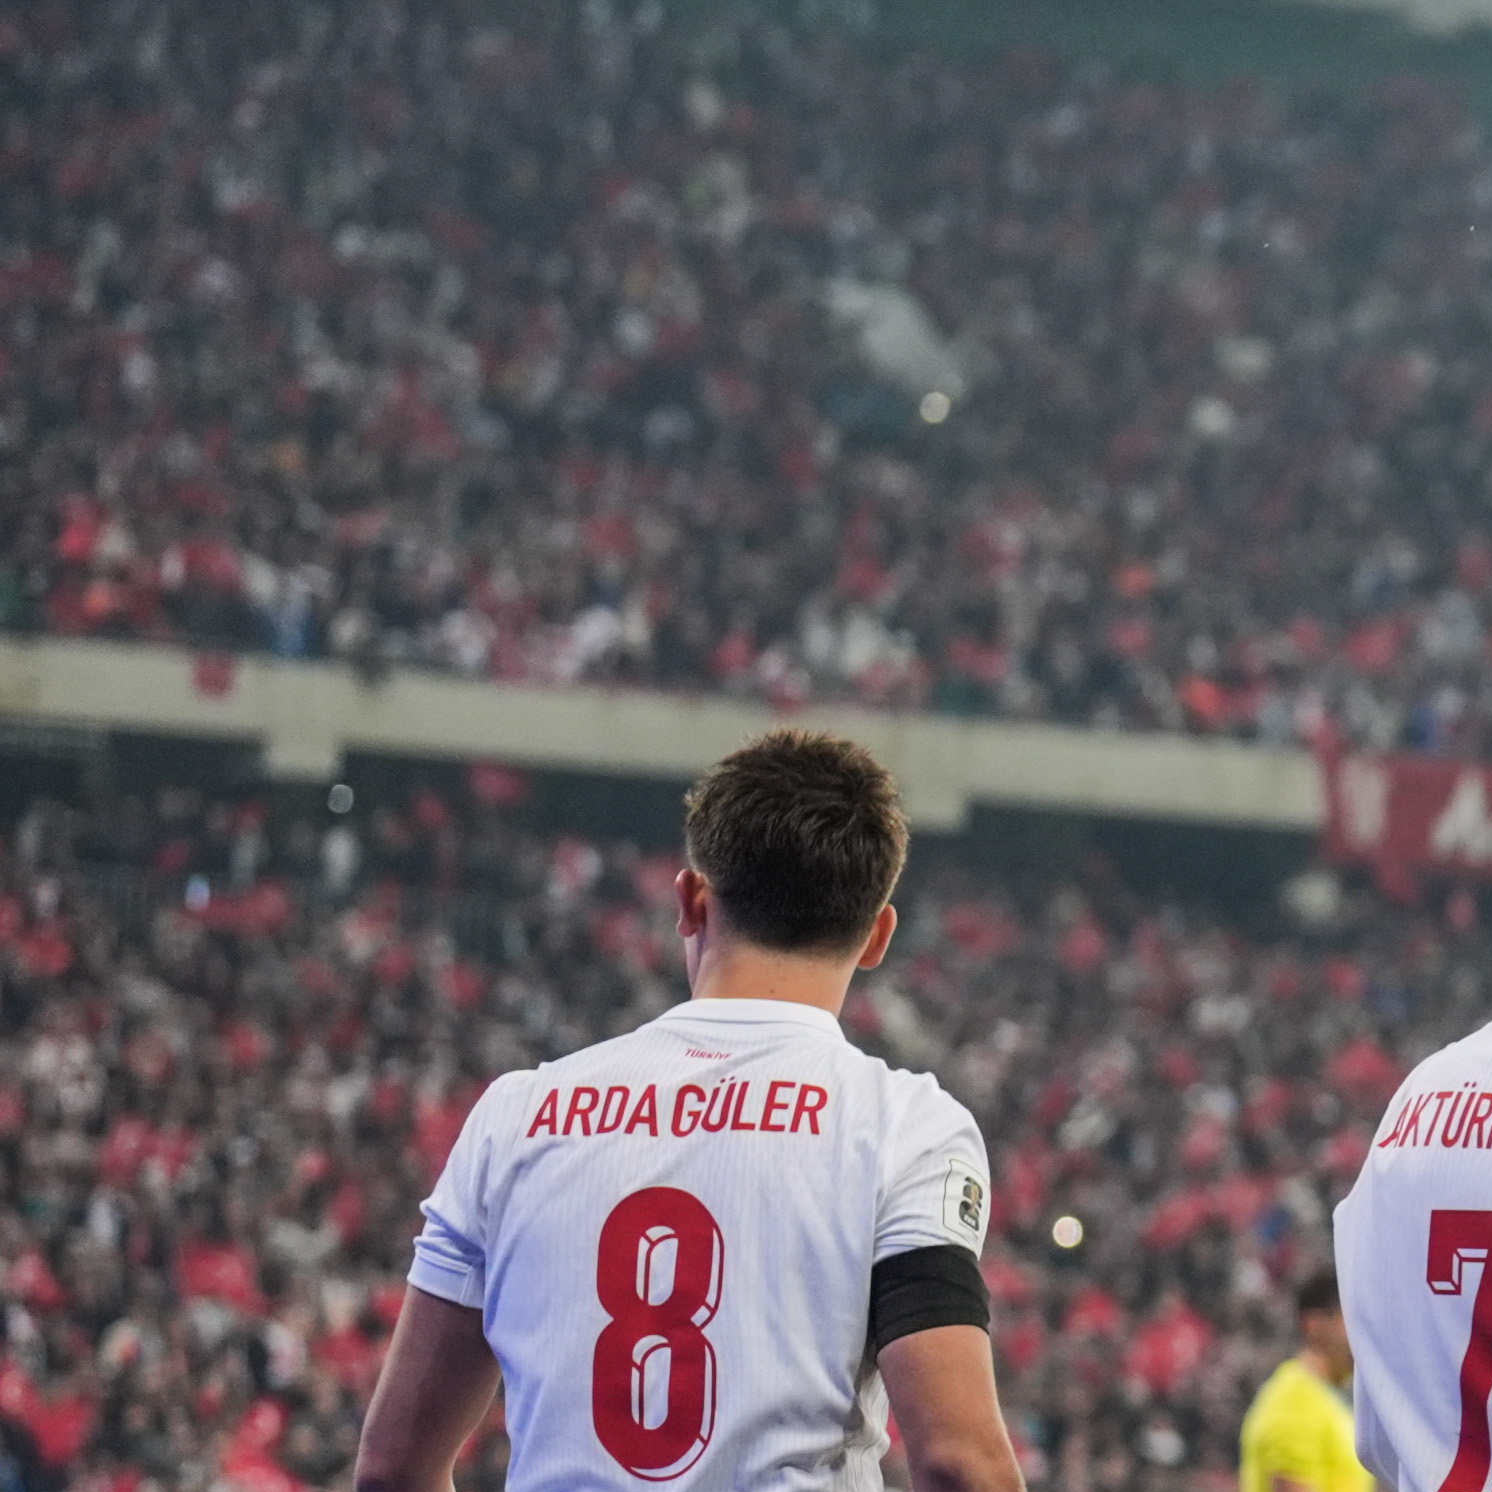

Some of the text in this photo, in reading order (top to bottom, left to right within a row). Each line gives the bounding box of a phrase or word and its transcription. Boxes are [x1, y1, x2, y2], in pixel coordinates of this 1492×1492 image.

[527, 1079, 830, 1138] ARDA GÜLER
[591, 1186, 726, 1482] 8
